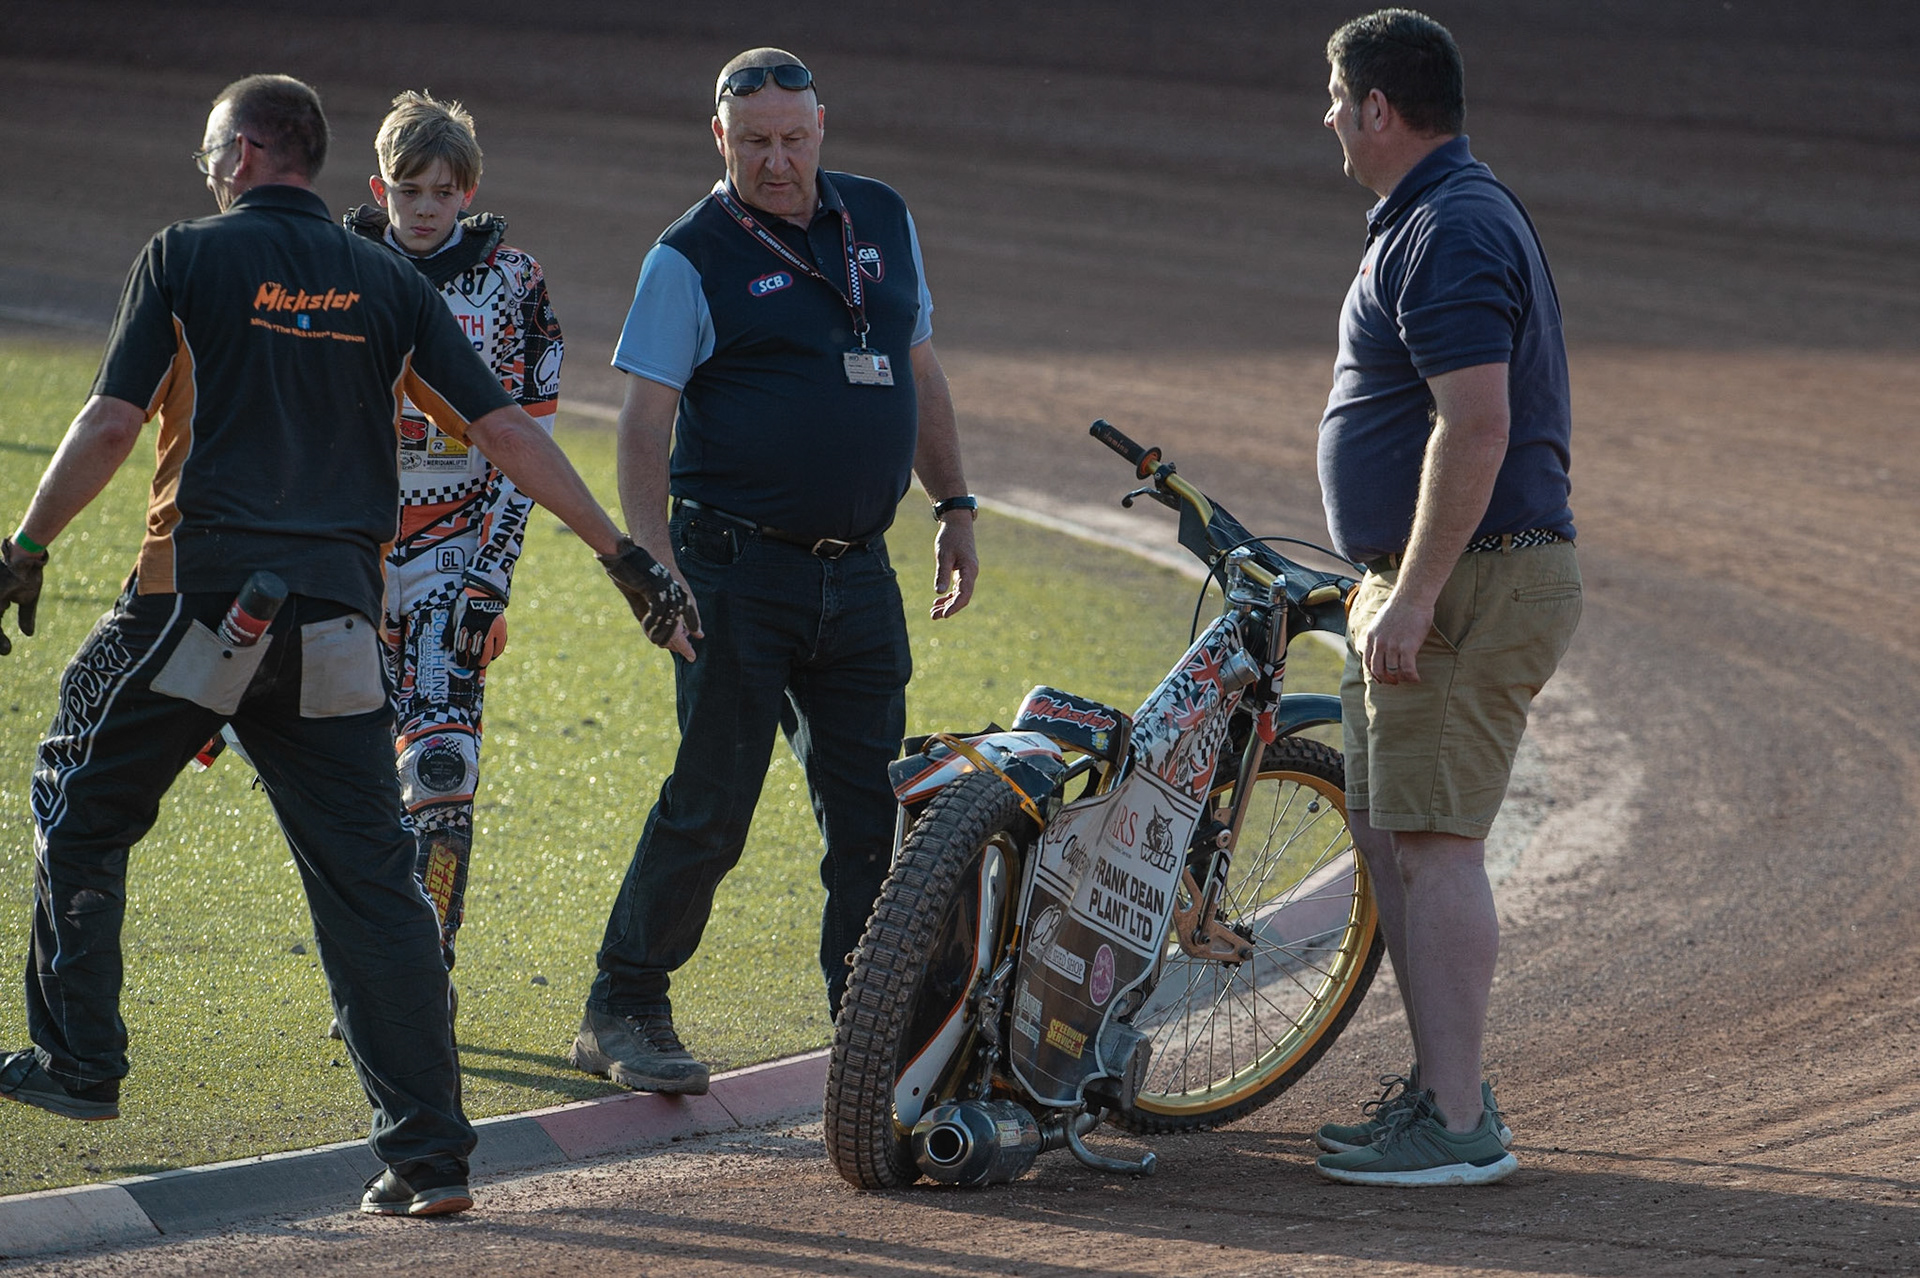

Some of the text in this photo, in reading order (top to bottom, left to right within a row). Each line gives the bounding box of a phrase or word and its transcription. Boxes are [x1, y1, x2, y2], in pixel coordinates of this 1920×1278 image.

[857, 247, 879, 260] GB
[462, 266, 490, 296] 87
[758, 275, 784, 293] SCB
[253, 282, 361, 313] Mickster
[477, 497, 527, 574] FRANK
[442, 551, 458, 568] GL
[1023, 698, 1117, 732] Mickster
[1092, 855, 1165, 916] FRANK DEAN
[1089, 887, 1153, 943] PLANT LTD
[1067, 953, 1084, 976] SHOP
[1050, 1018, 1088, 1044] SPEEDWAY
